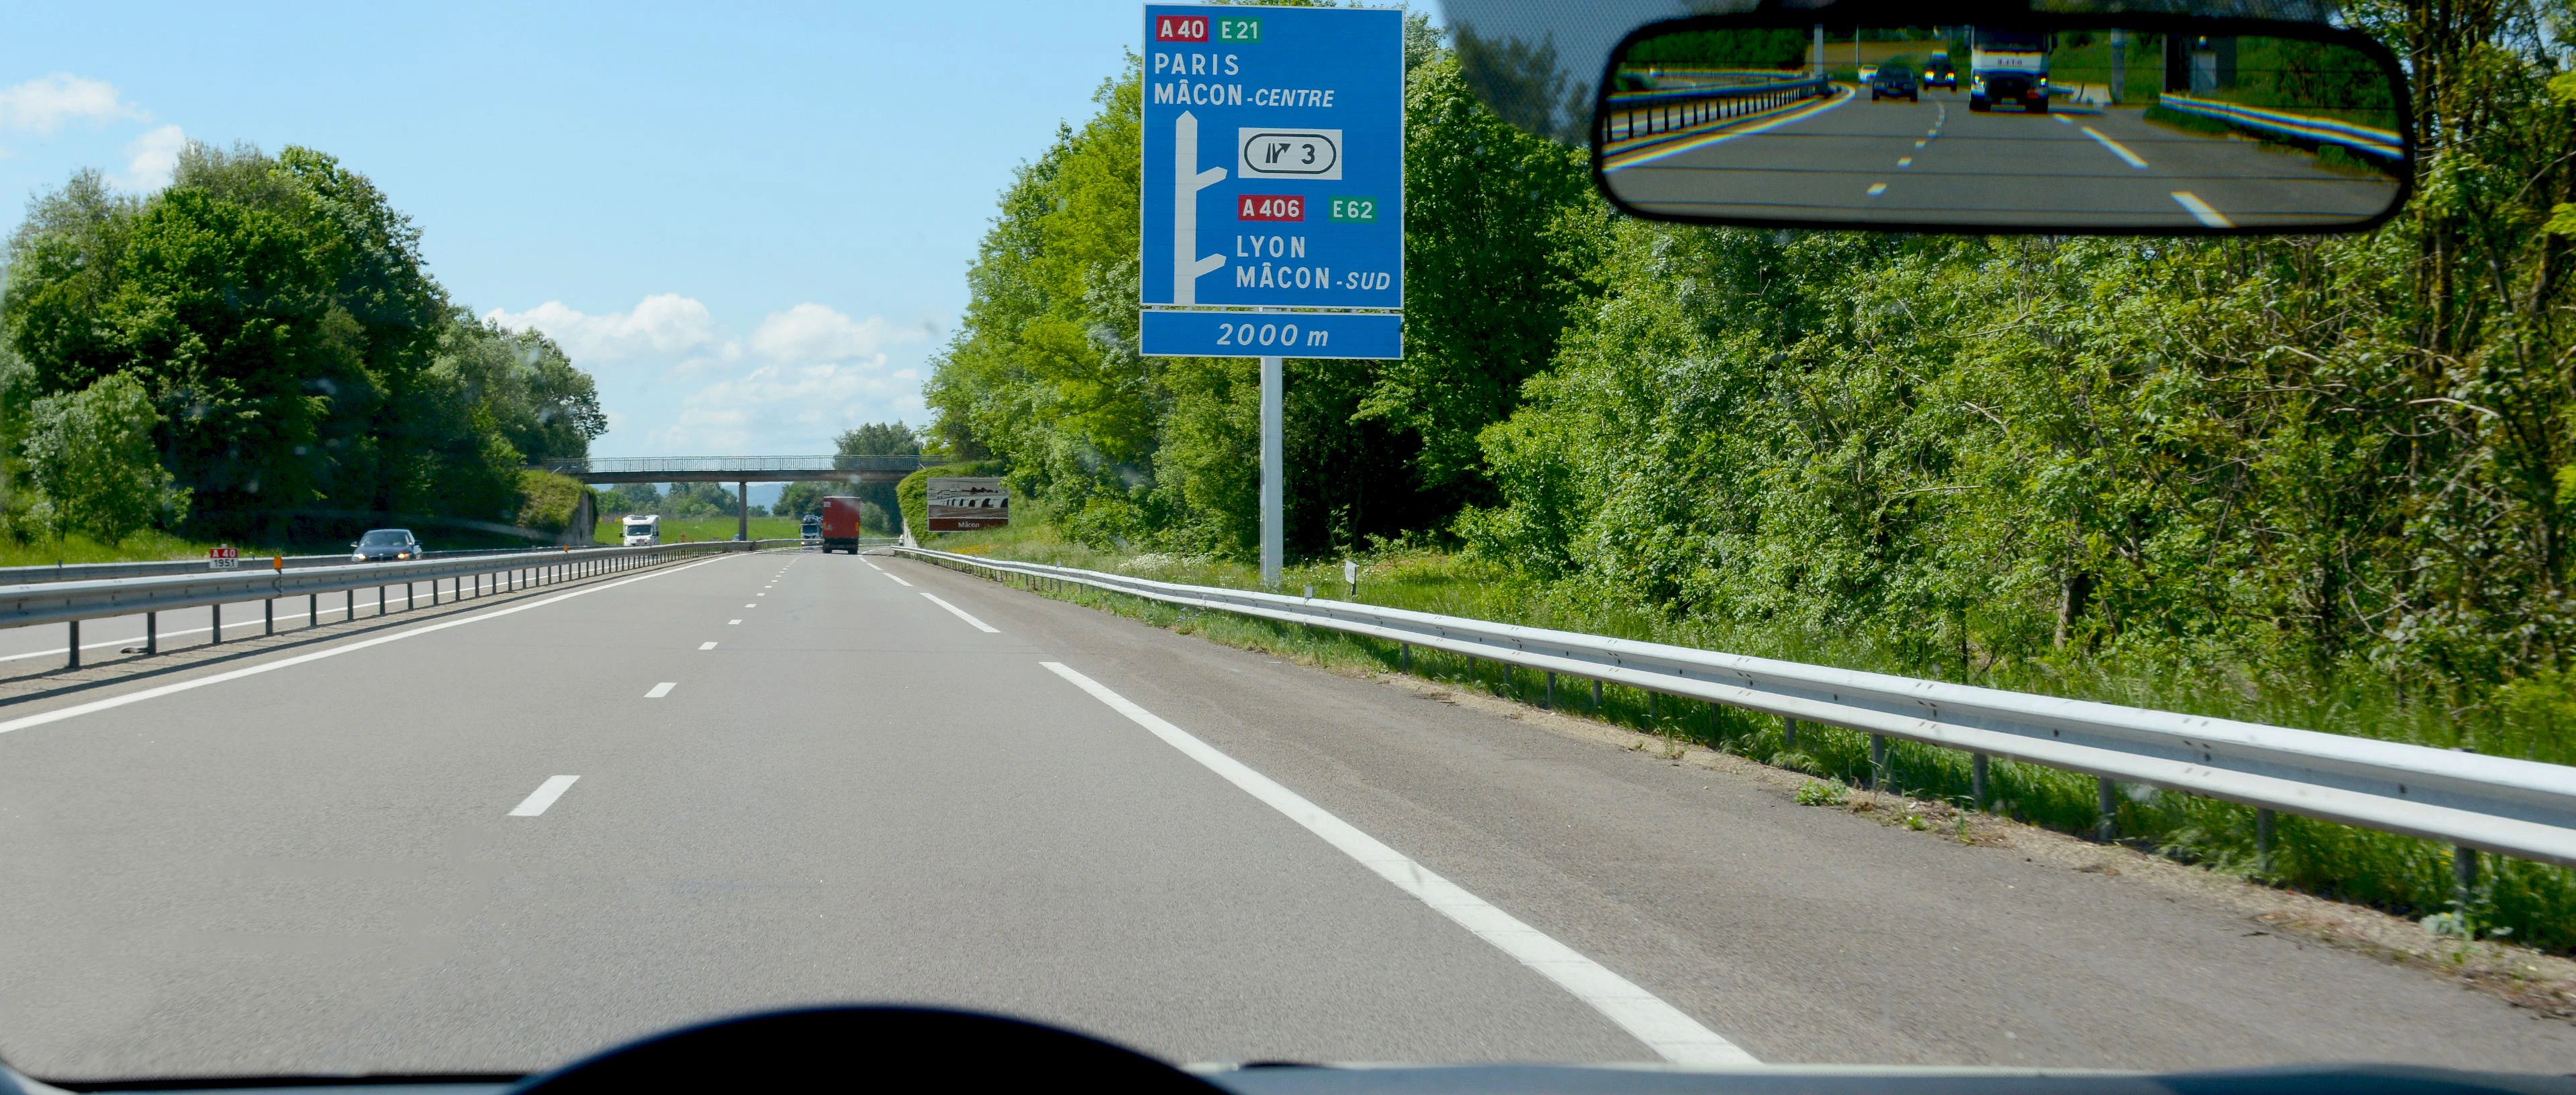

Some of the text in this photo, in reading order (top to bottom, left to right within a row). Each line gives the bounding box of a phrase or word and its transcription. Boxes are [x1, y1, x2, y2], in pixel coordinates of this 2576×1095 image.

[1155, 52, 1239, 76] PARIS
[1301, 144, 1316, 165] 3
[1237, 235, 1305, 258] LYON
[1216, 323, 1328, 347] 2000 m
[213, 550, 236, 558] A 40
[214, 559, 234, 568] 1951
